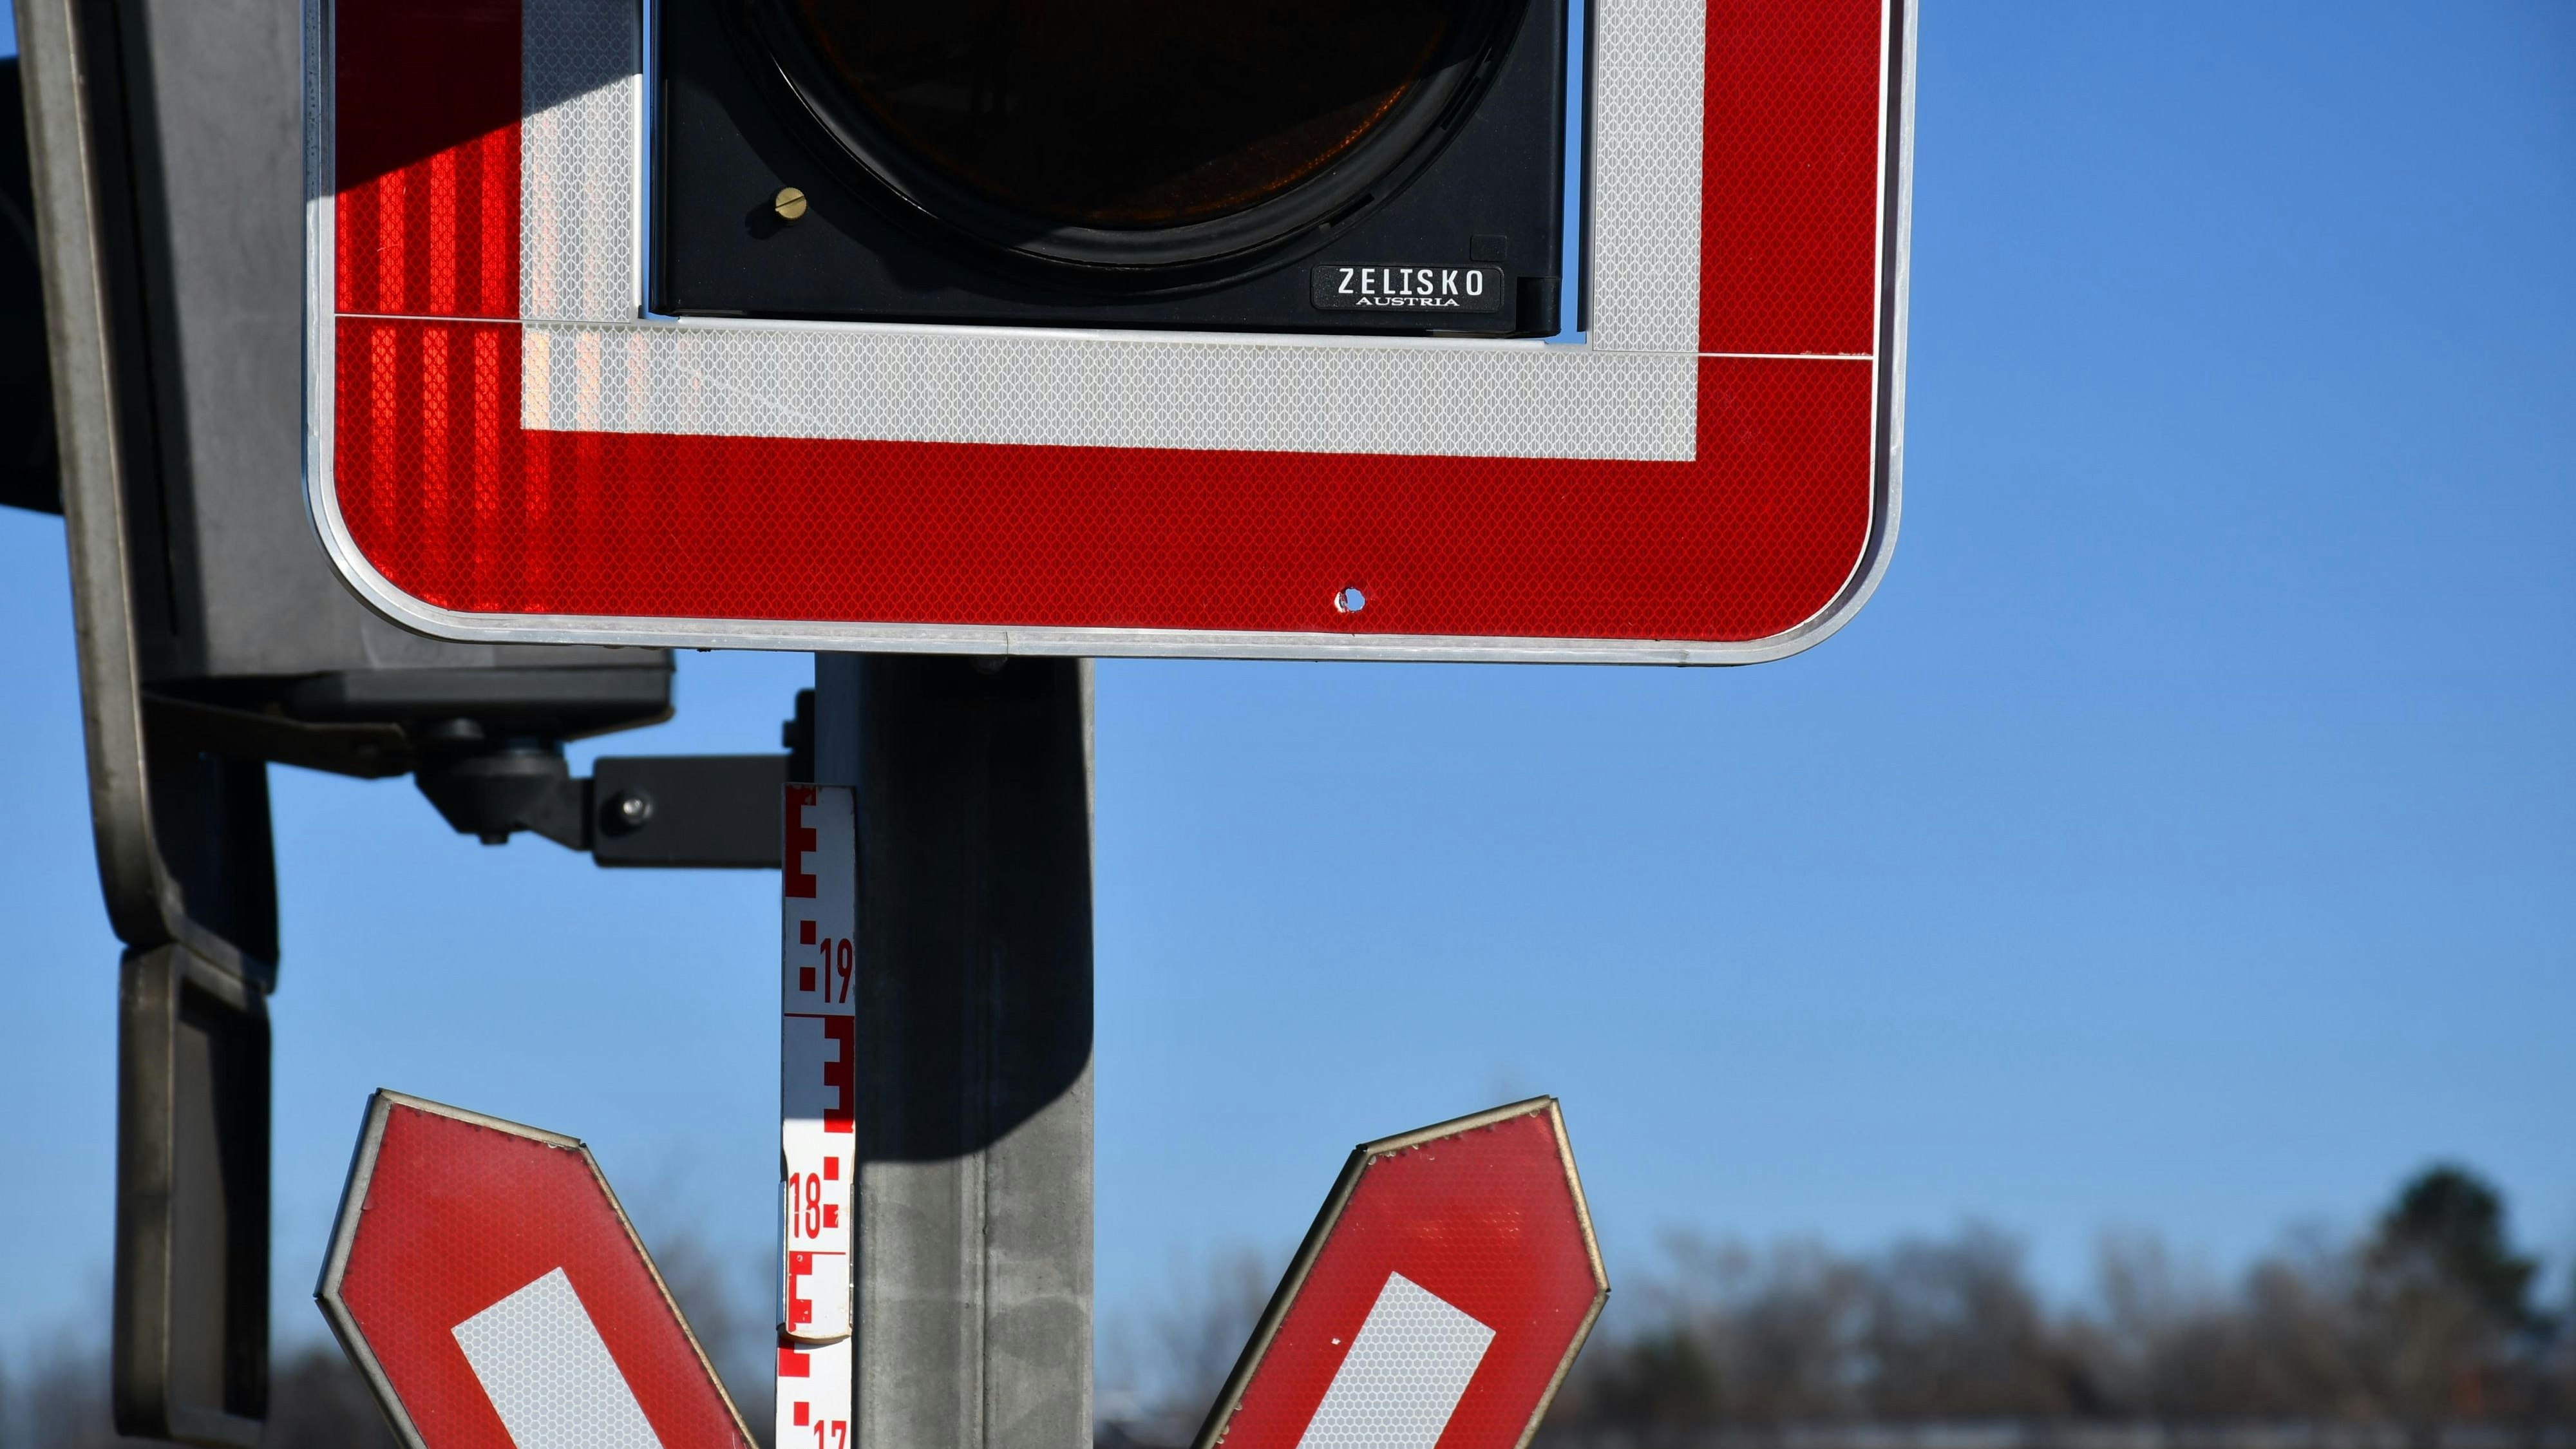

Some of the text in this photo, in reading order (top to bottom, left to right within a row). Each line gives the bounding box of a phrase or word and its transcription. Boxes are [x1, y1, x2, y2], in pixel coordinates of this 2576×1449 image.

[1338, 267, 1483, 296] ZELISKO
[1355, 296, 1461, 307] AUSTRIA
[820, 937, 853, 1004] 19
[789, 1172, 821, 1240] 18
